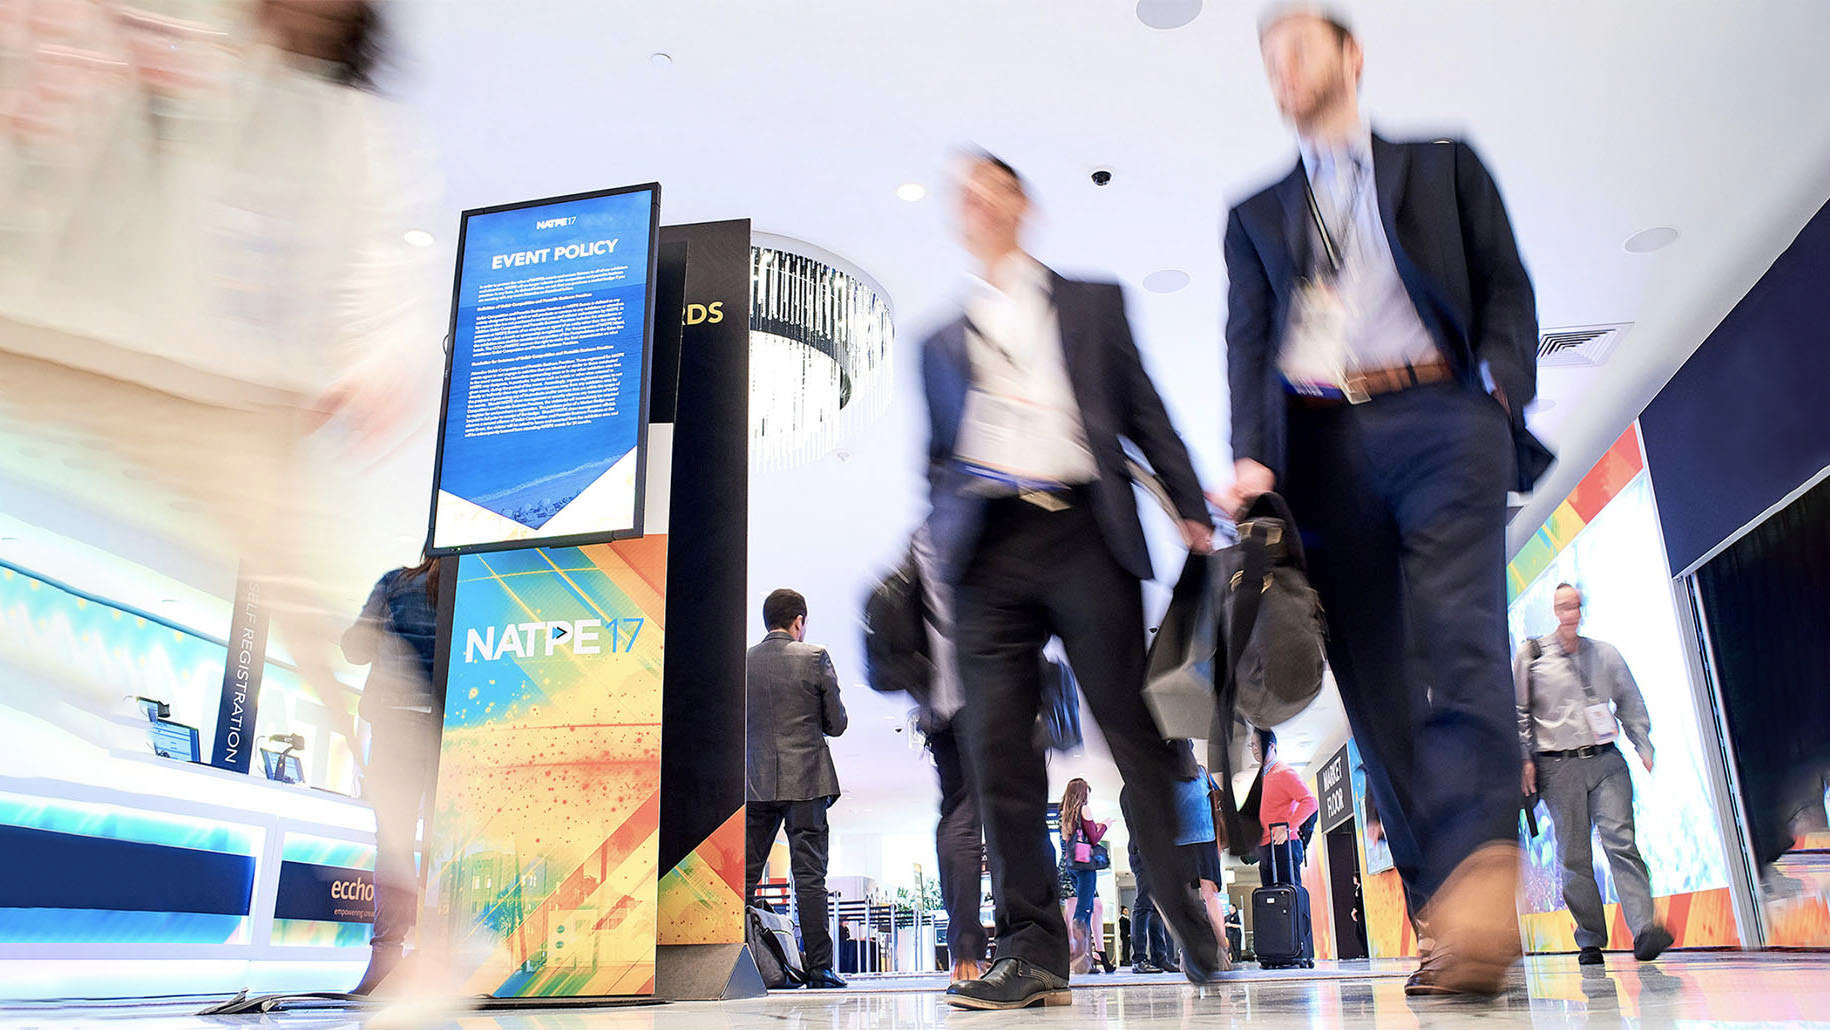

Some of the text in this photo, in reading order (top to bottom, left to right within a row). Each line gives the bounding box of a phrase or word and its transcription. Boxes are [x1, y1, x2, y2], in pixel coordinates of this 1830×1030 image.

[491, 238, 619, 270] EVENT POLICY
[682, 301, 724, 326] DS
[465, 619, 601, 663] NATPE
[225, 582, 260, 763] SELF REGISTRATION
[1322, 755, 1342, 792] MARKET
[1326, 787, 1345, 818] FLOOR
